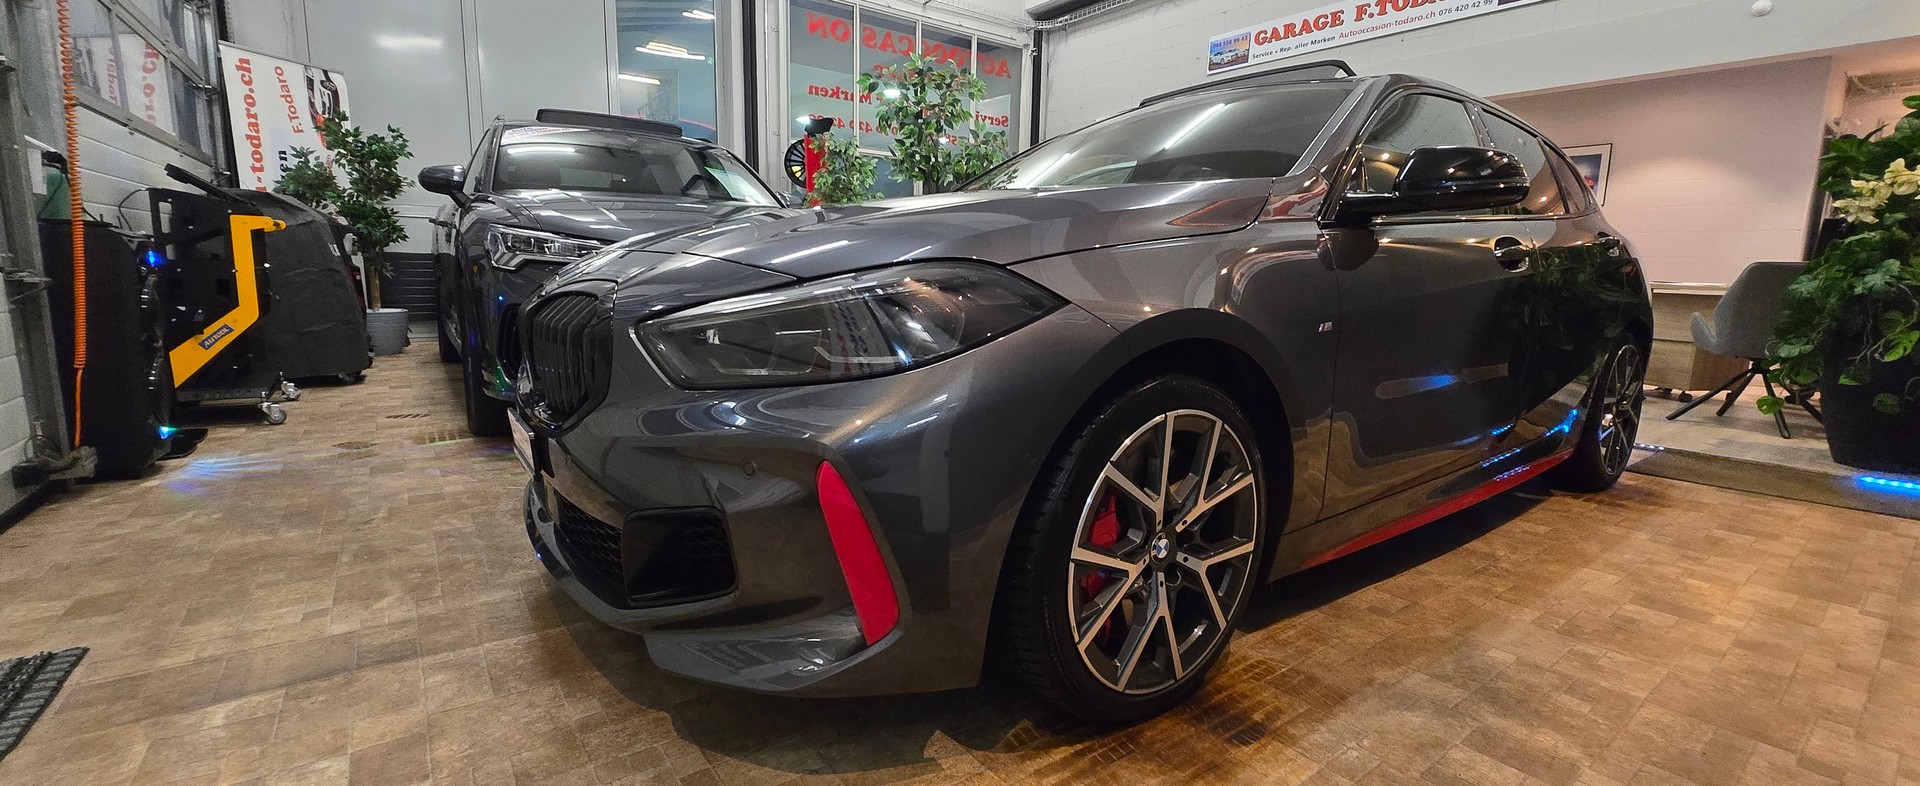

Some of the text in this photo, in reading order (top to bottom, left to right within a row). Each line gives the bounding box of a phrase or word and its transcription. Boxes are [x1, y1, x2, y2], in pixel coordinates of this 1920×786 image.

[1212, 42, 1222, 50] 044
[1252, 50, 1274, 59] Service
[1279, 46, 1292, 54] Rep.
[1294, 42, 1309, 50] aller
[1310, 36, 1336, 46] Marken
[1338, 10, 1436, 39] Autooccasion-todaro.ch
[1438, 8, 1453, 16] 076
[1454, 3, 1469, 12] 420
[1254, 0, 1447, 46] GARAGE F.TO
[234, 57, 268, 192] -todaro.ch
[204, 327, 229, 349] AUTOOL
